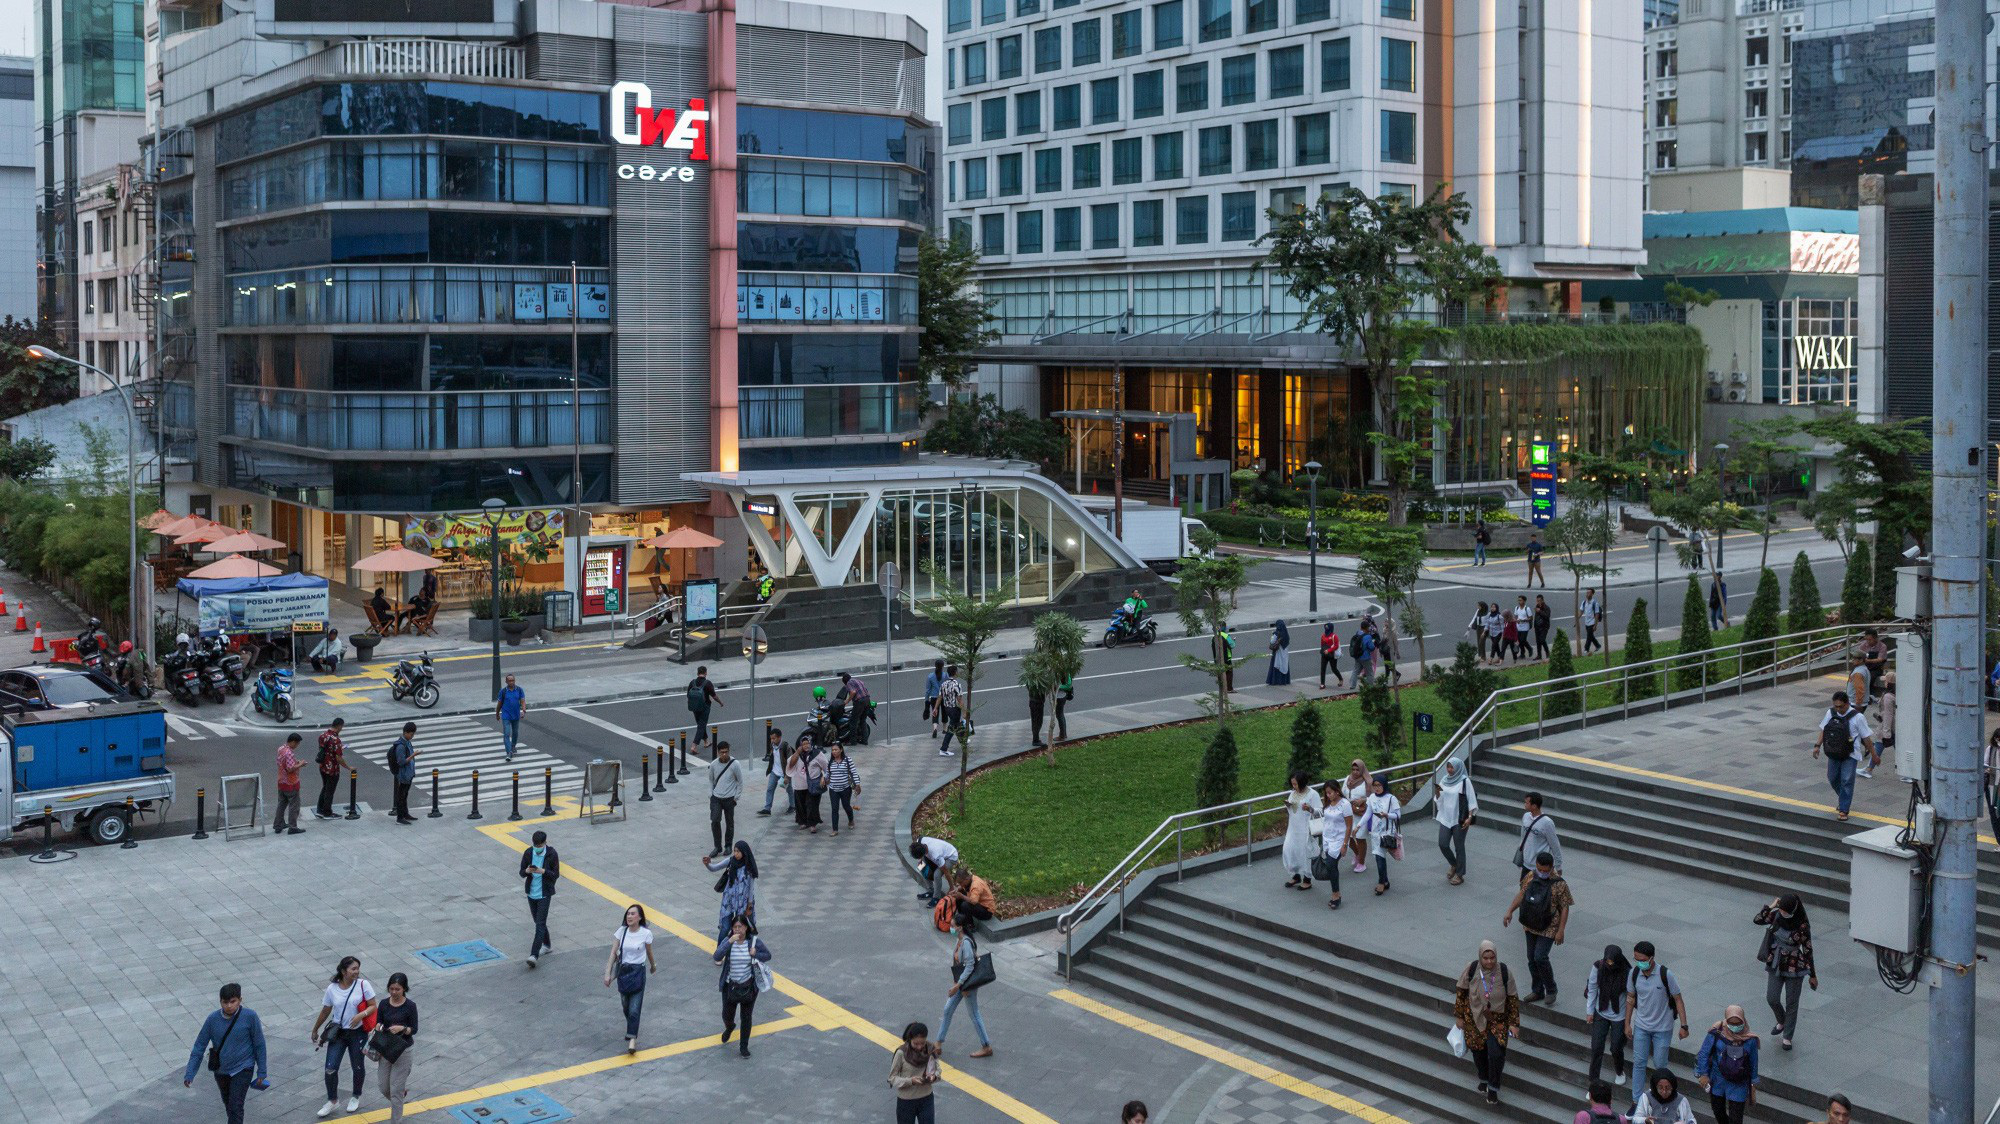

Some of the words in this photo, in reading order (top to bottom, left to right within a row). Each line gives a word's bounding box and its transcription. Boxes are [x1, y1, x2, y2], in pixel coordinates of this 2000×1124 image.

[1794, 335, 1853, 370] WAKI
[449, 523, 478, 538] Harga
[480, 523, 524, 536] Mkanan
[275, 593, 326, 604] PENGAMANAN
[284, 604, 311, 612] JAKARTA
